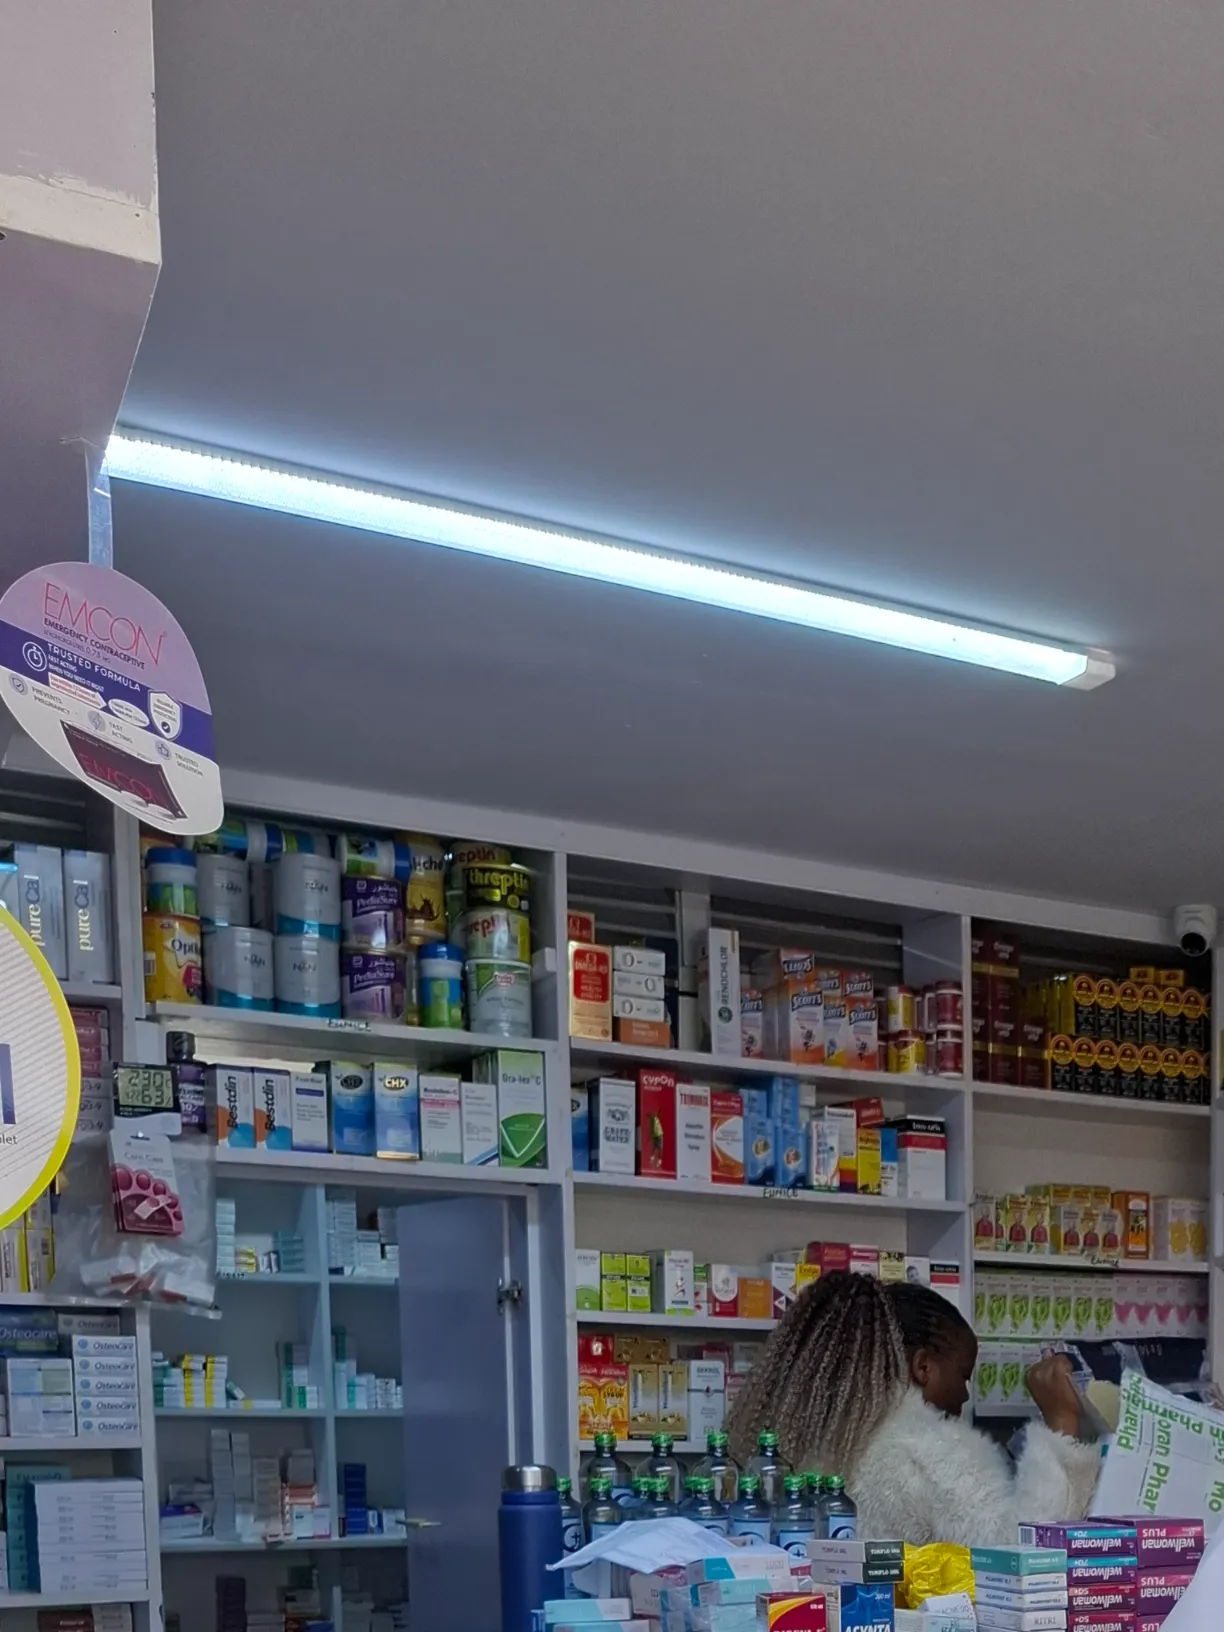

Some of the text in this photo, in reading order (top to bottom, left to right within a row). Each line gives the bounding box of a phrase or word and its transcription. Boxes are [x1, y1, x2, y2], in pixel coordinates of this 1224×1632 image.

[44, 582, 164, 665] EMCON
[44, 617, 145, 670] EMERGENCY CONTRACEPTIVE
[48, 643, 92, 670] TRUSTED
[94, 665, 141, 692] FORMULA
[72, 879, 94, 951] pureCal
[383, 1076, 408, 1089] CHX
[227, 1075, 239, 1129] Bestdin
[264, 1078, 277, 1132] Bestdin
[1143, 1528, 1166, 1537] PLUS
[1072, 1538, 1121, 1551] wellwoman
[1142, 1538, 1195, 1552] wellwoman
[1073, 1567, 1122, 1580] wellwoman
[1142, 1576, 1165, 1586] PLUS
[1073, 1595, 1122, 1608] wellwoman
[1034, 1615, 1057, 1626] RITRI
